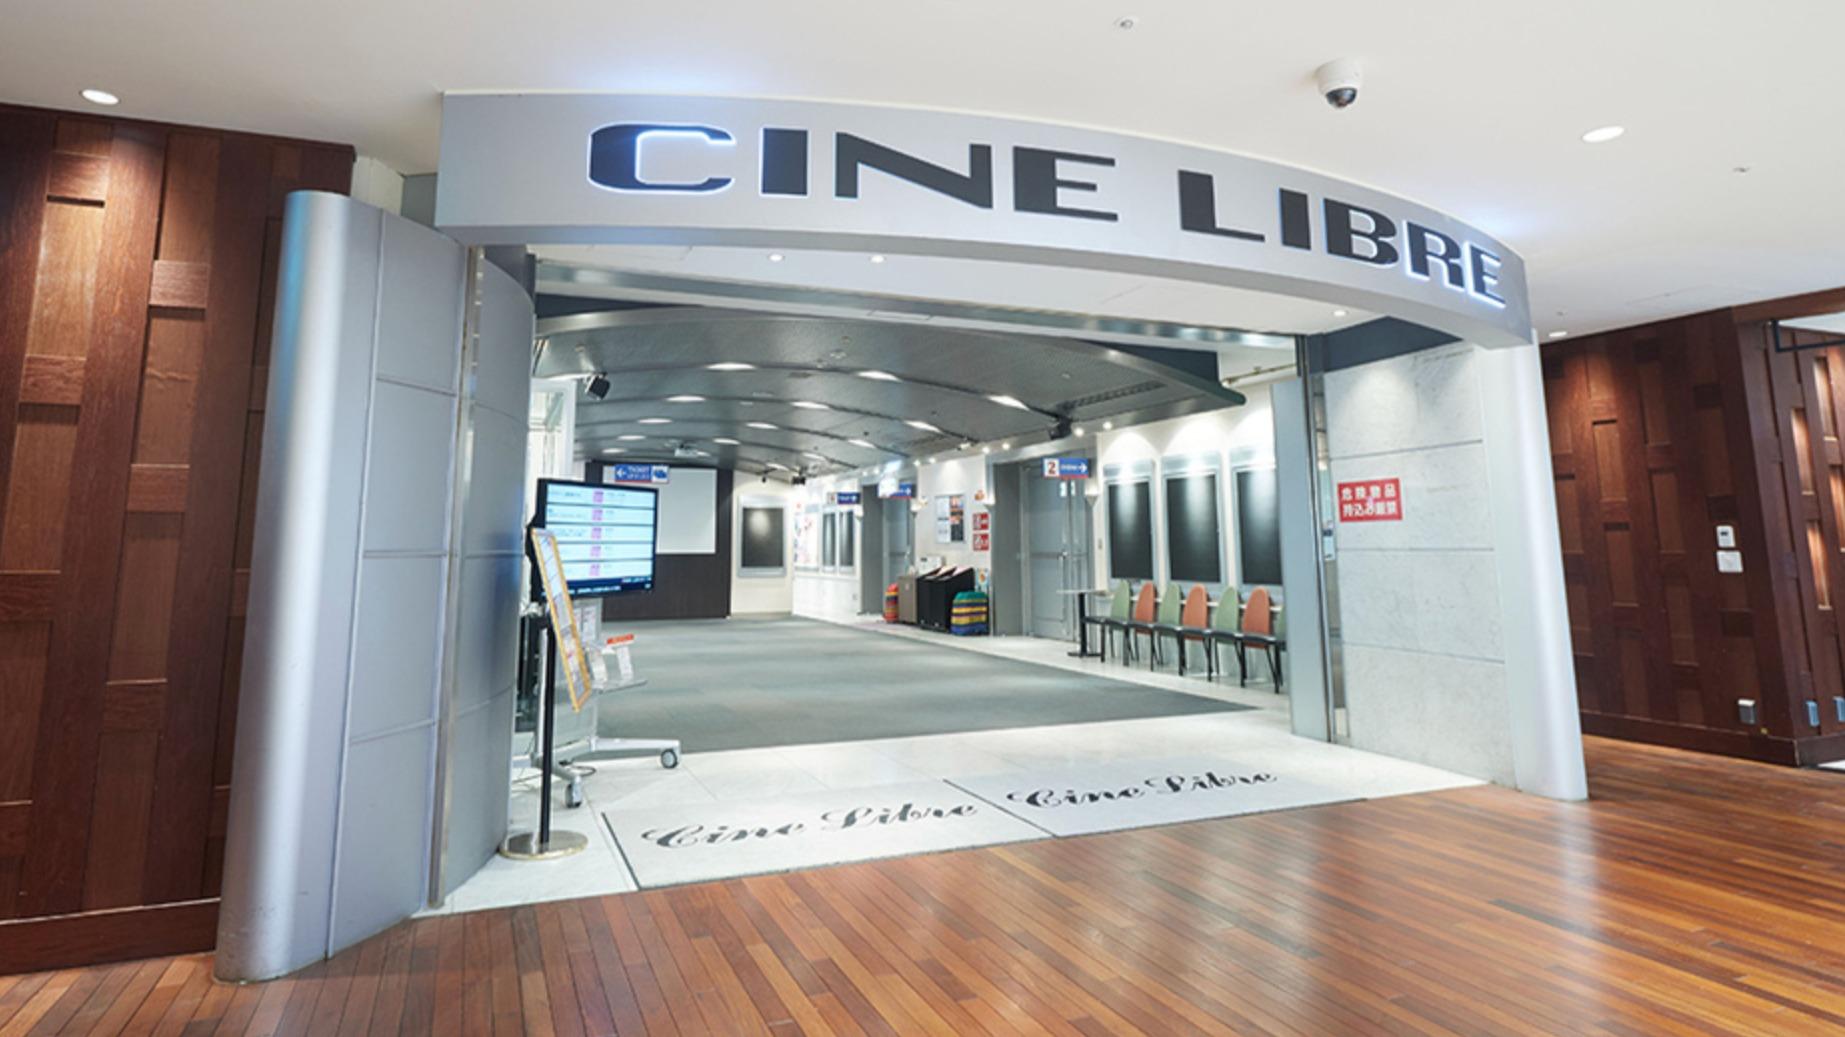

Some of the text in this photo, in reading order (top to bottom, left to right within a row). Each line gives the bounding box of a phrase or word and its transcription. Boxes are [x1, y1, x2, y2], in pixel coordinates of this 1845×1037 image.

[588, 123, 1507, 308] CINE LIBRE
[1048, 462, 1056, 475] 2
[1006, 772, 1277, 807] Cine Libre
[641, 803, 977, 848] Cine Libre
